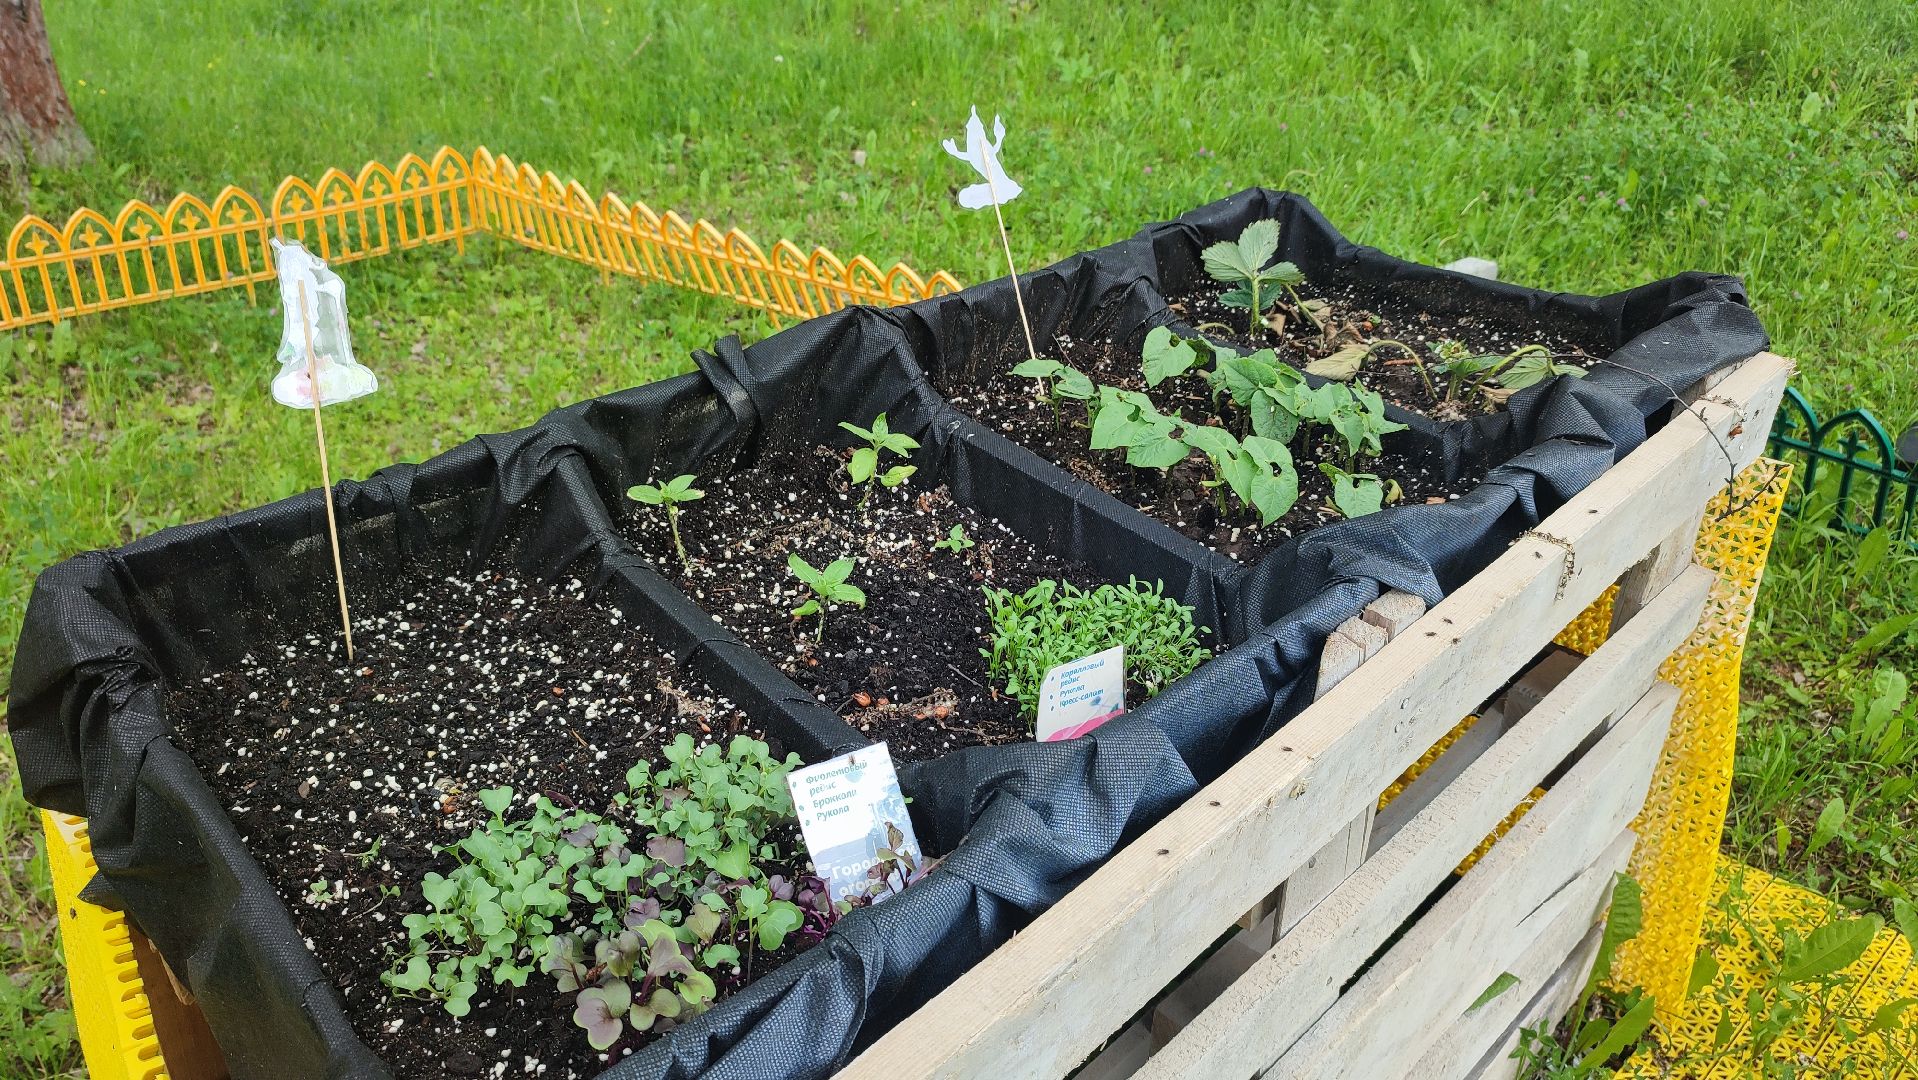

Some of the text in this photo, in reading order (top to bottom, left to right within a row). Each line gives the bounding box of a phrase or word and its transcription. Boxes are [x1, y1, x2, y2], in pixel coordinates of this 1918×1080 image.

[805, 760, 868, 784] Фиолетовый
[812, 789, 857, 809] Брокколи
[816, 804, 850, 822] Рукола
